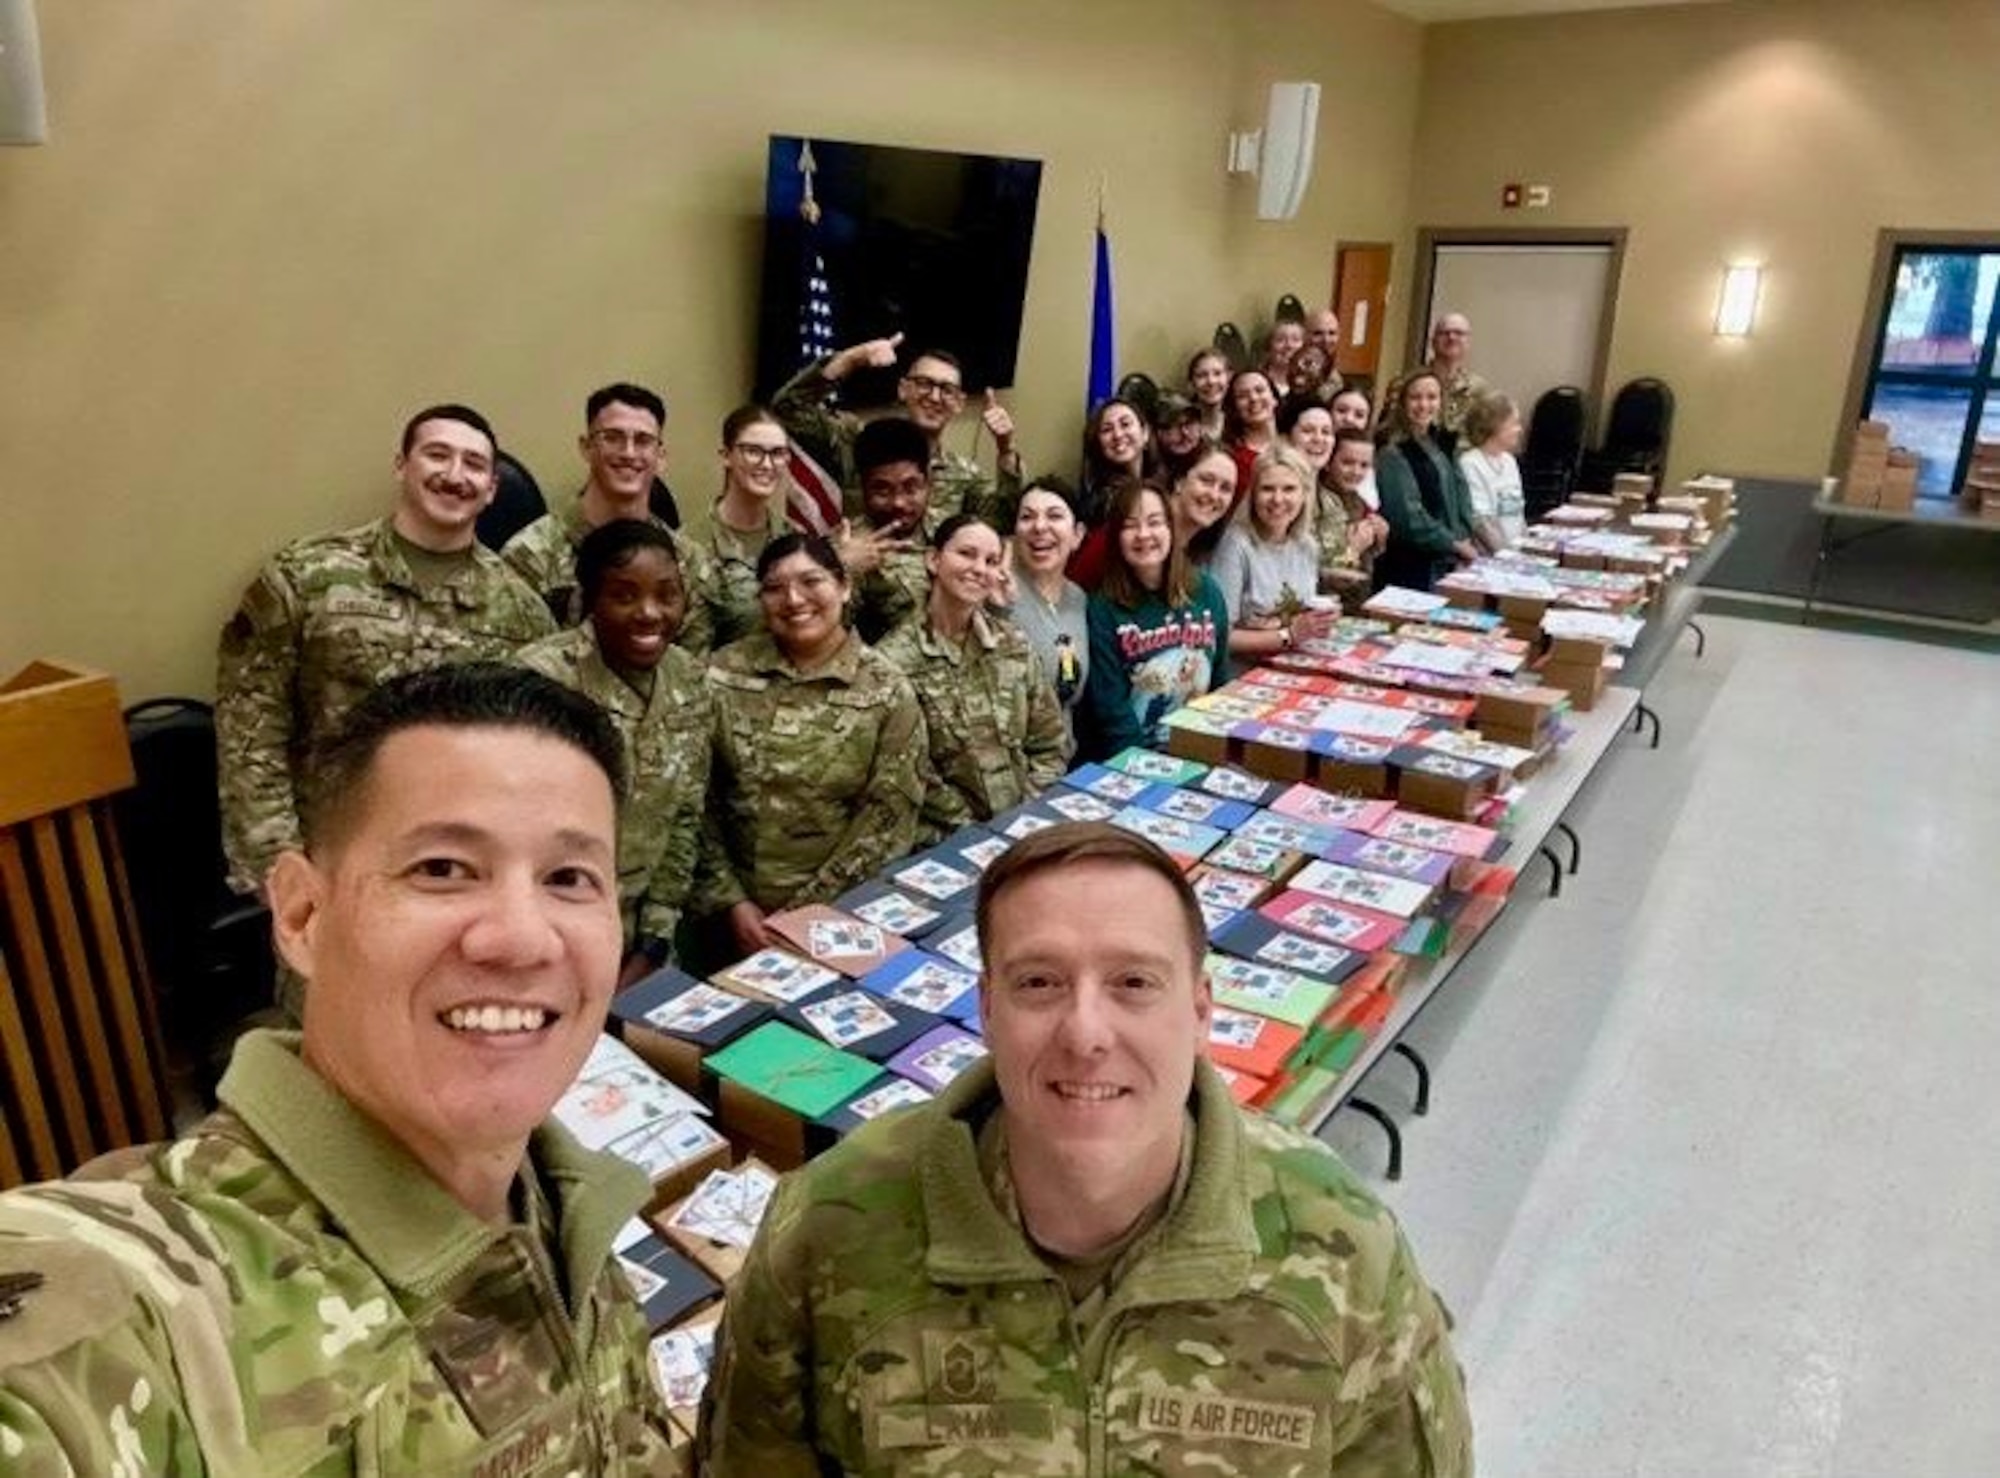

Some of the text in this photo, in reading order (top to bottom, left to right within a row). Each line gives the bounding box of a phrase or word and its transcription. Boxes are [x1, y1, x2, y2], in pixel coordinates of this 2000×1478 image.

[1149, 1398, 1303, 1442] US AIR FORCE
